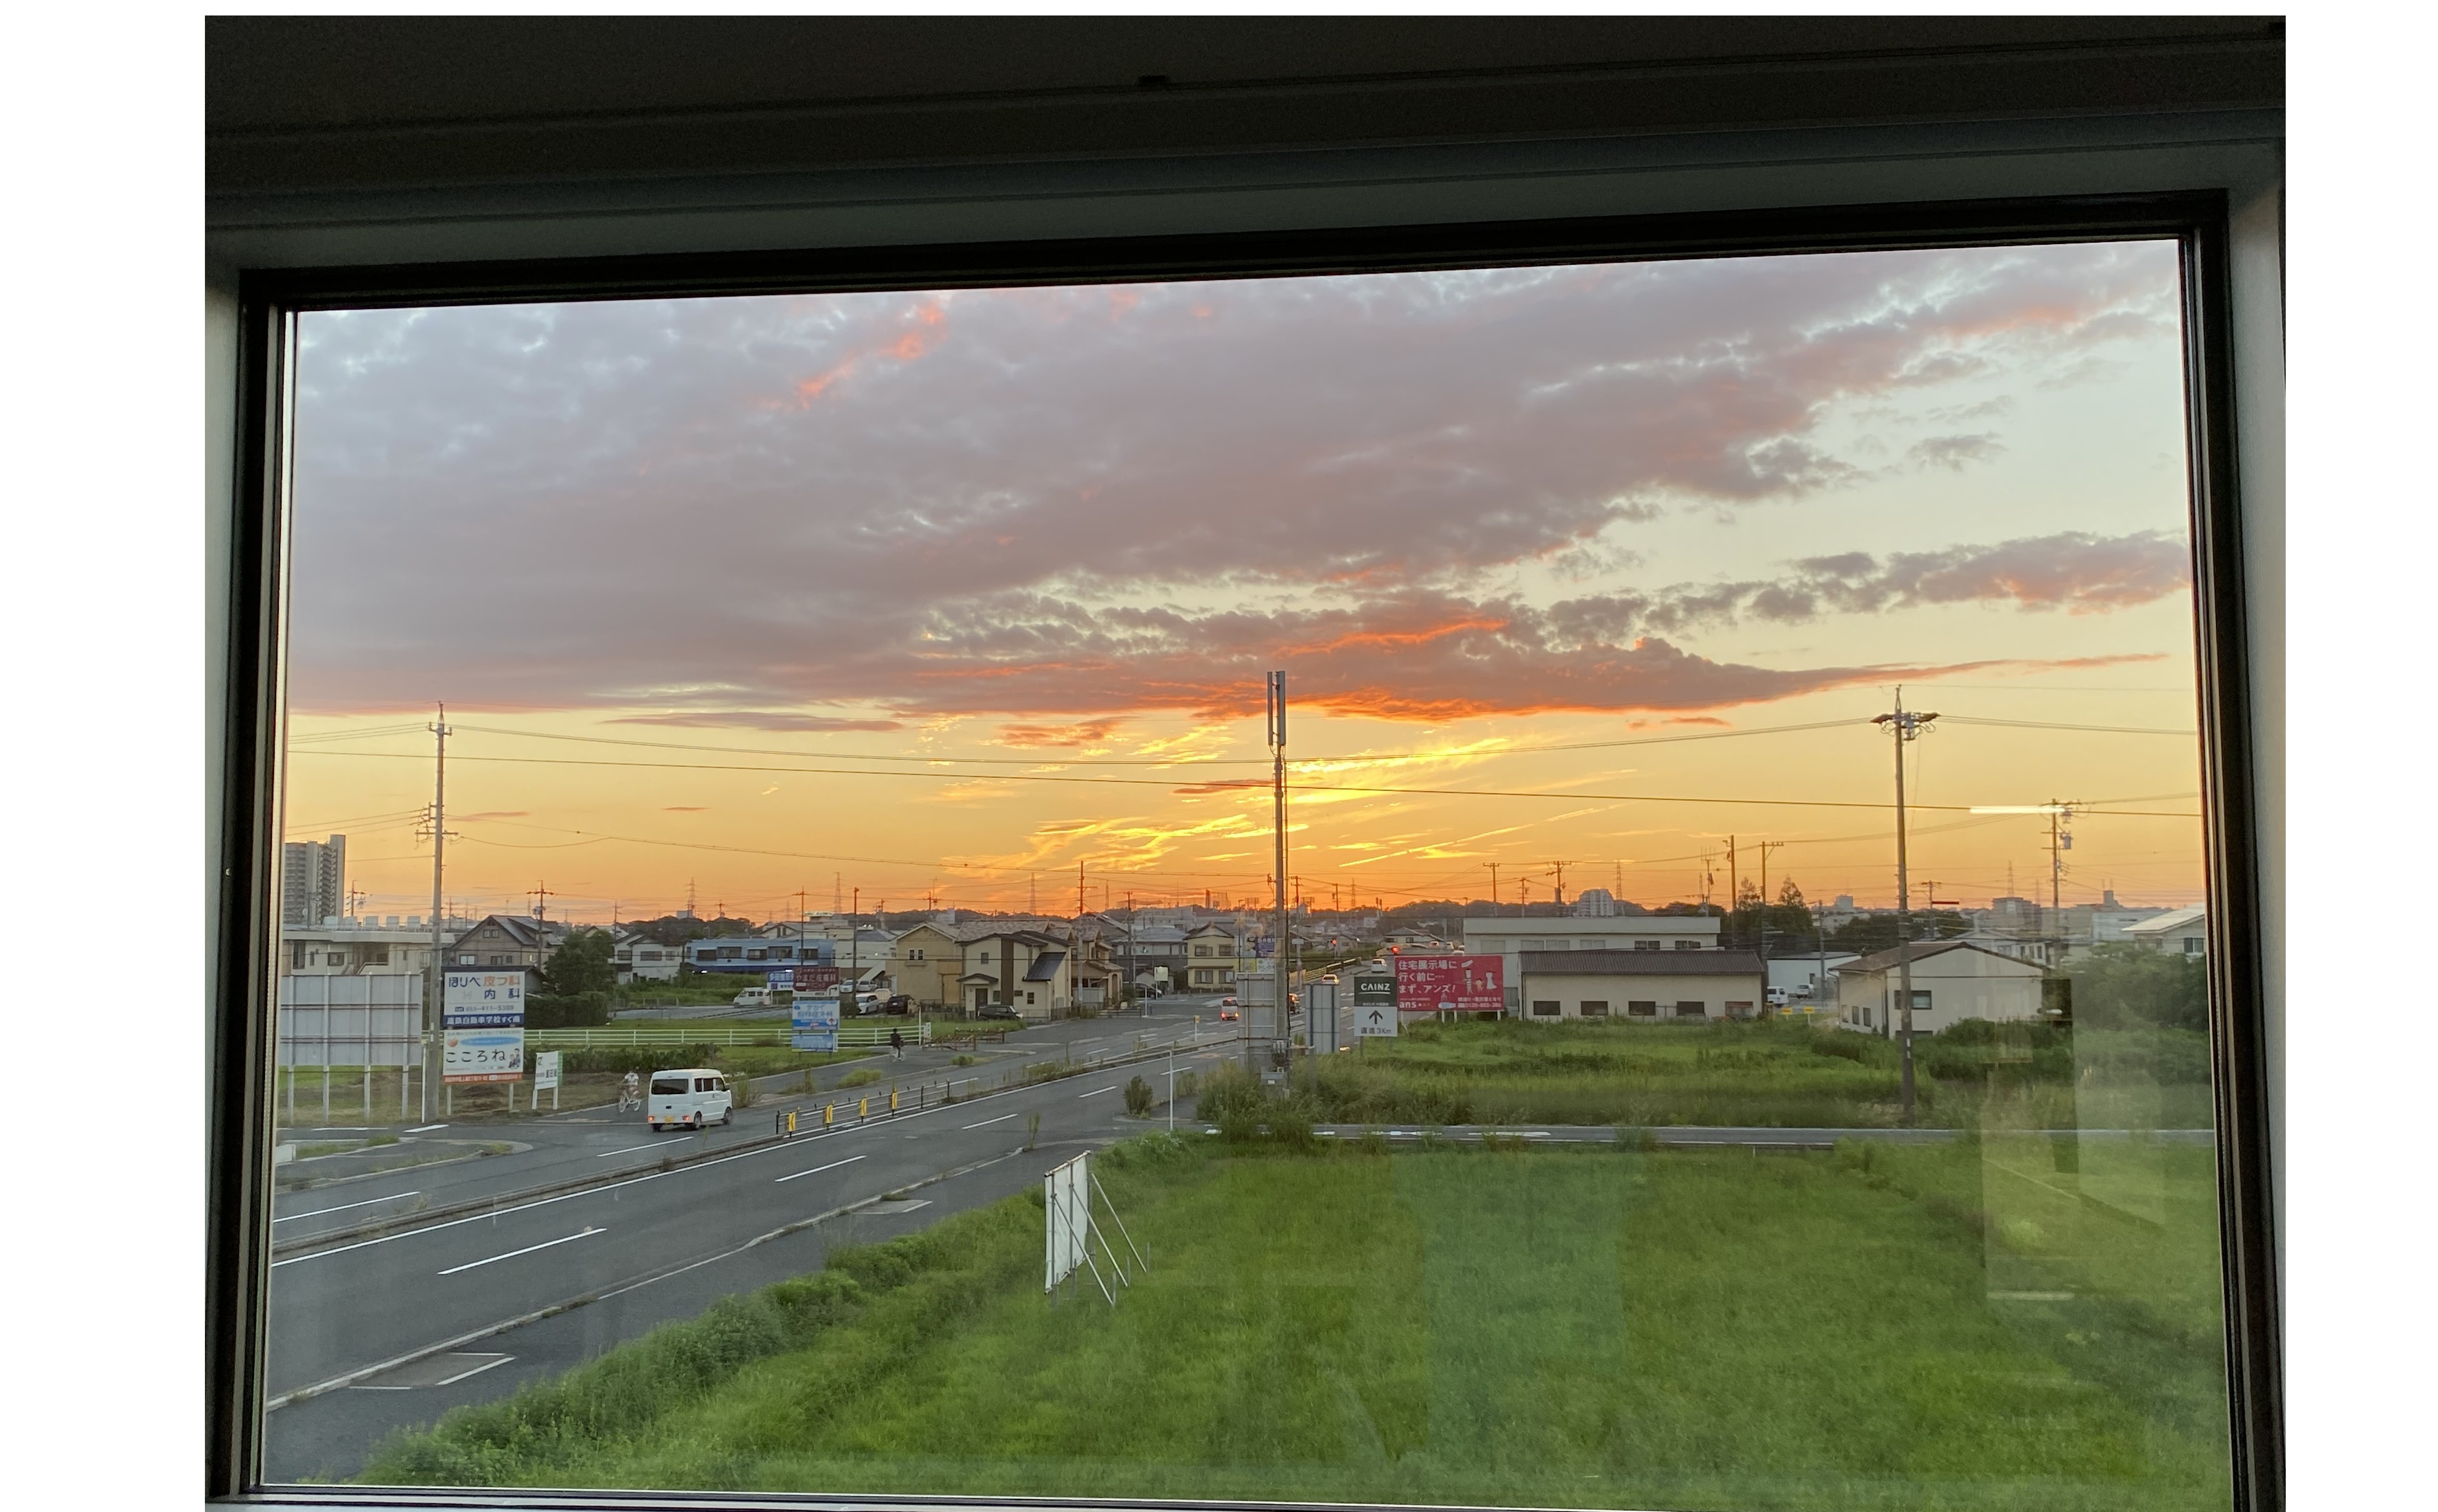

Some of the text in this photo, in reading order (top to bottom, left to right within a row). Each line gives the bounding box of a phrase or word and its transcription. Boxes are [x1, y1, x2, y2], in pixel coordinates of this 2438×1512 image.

[1398, 960, 1457, 970] 住宅展示場に
[449, 977, 481, 988] ほりべ
[1361, 983, 1391, 991] CAINZ
[446, 1049, 506, 1063] こころね
